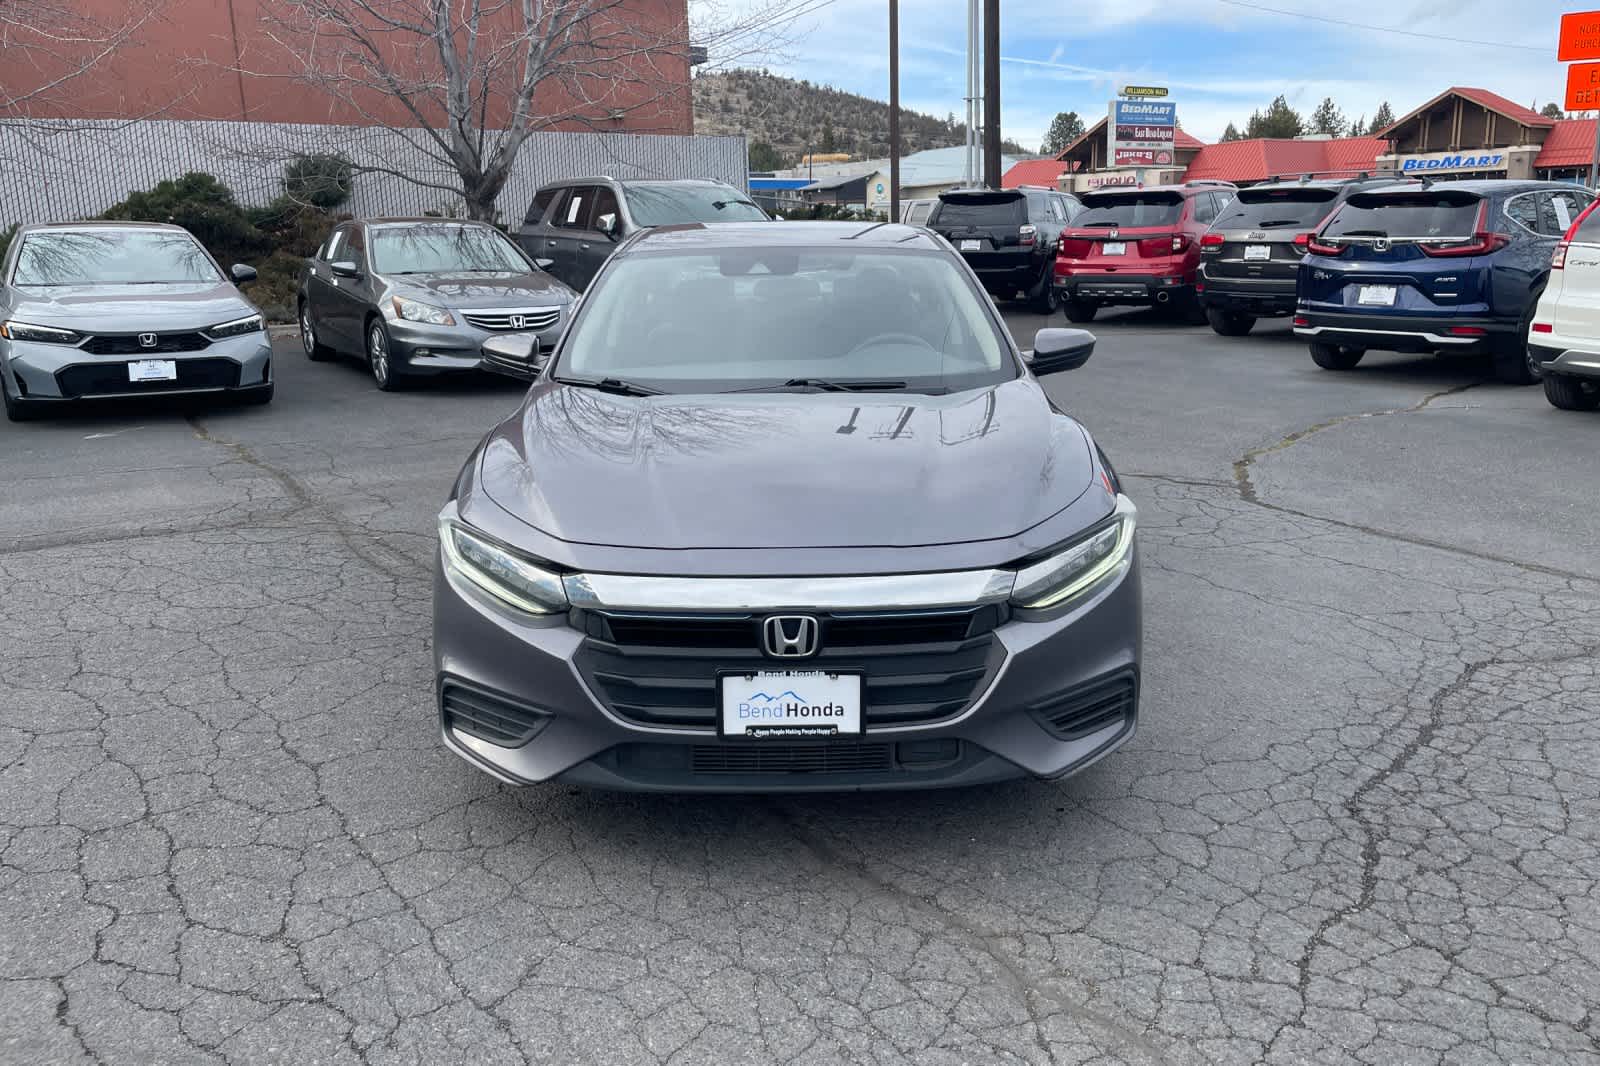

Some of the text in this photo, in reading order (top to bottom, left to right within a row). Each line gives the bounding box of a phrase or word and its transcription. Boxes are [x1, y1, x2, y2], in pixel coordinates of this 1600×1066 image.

[1121, 103, 1171, 114] BEDMART
[1403, 155, 1502, 171] BEDMART
[739, 702, 844, 718] Bend Honda
